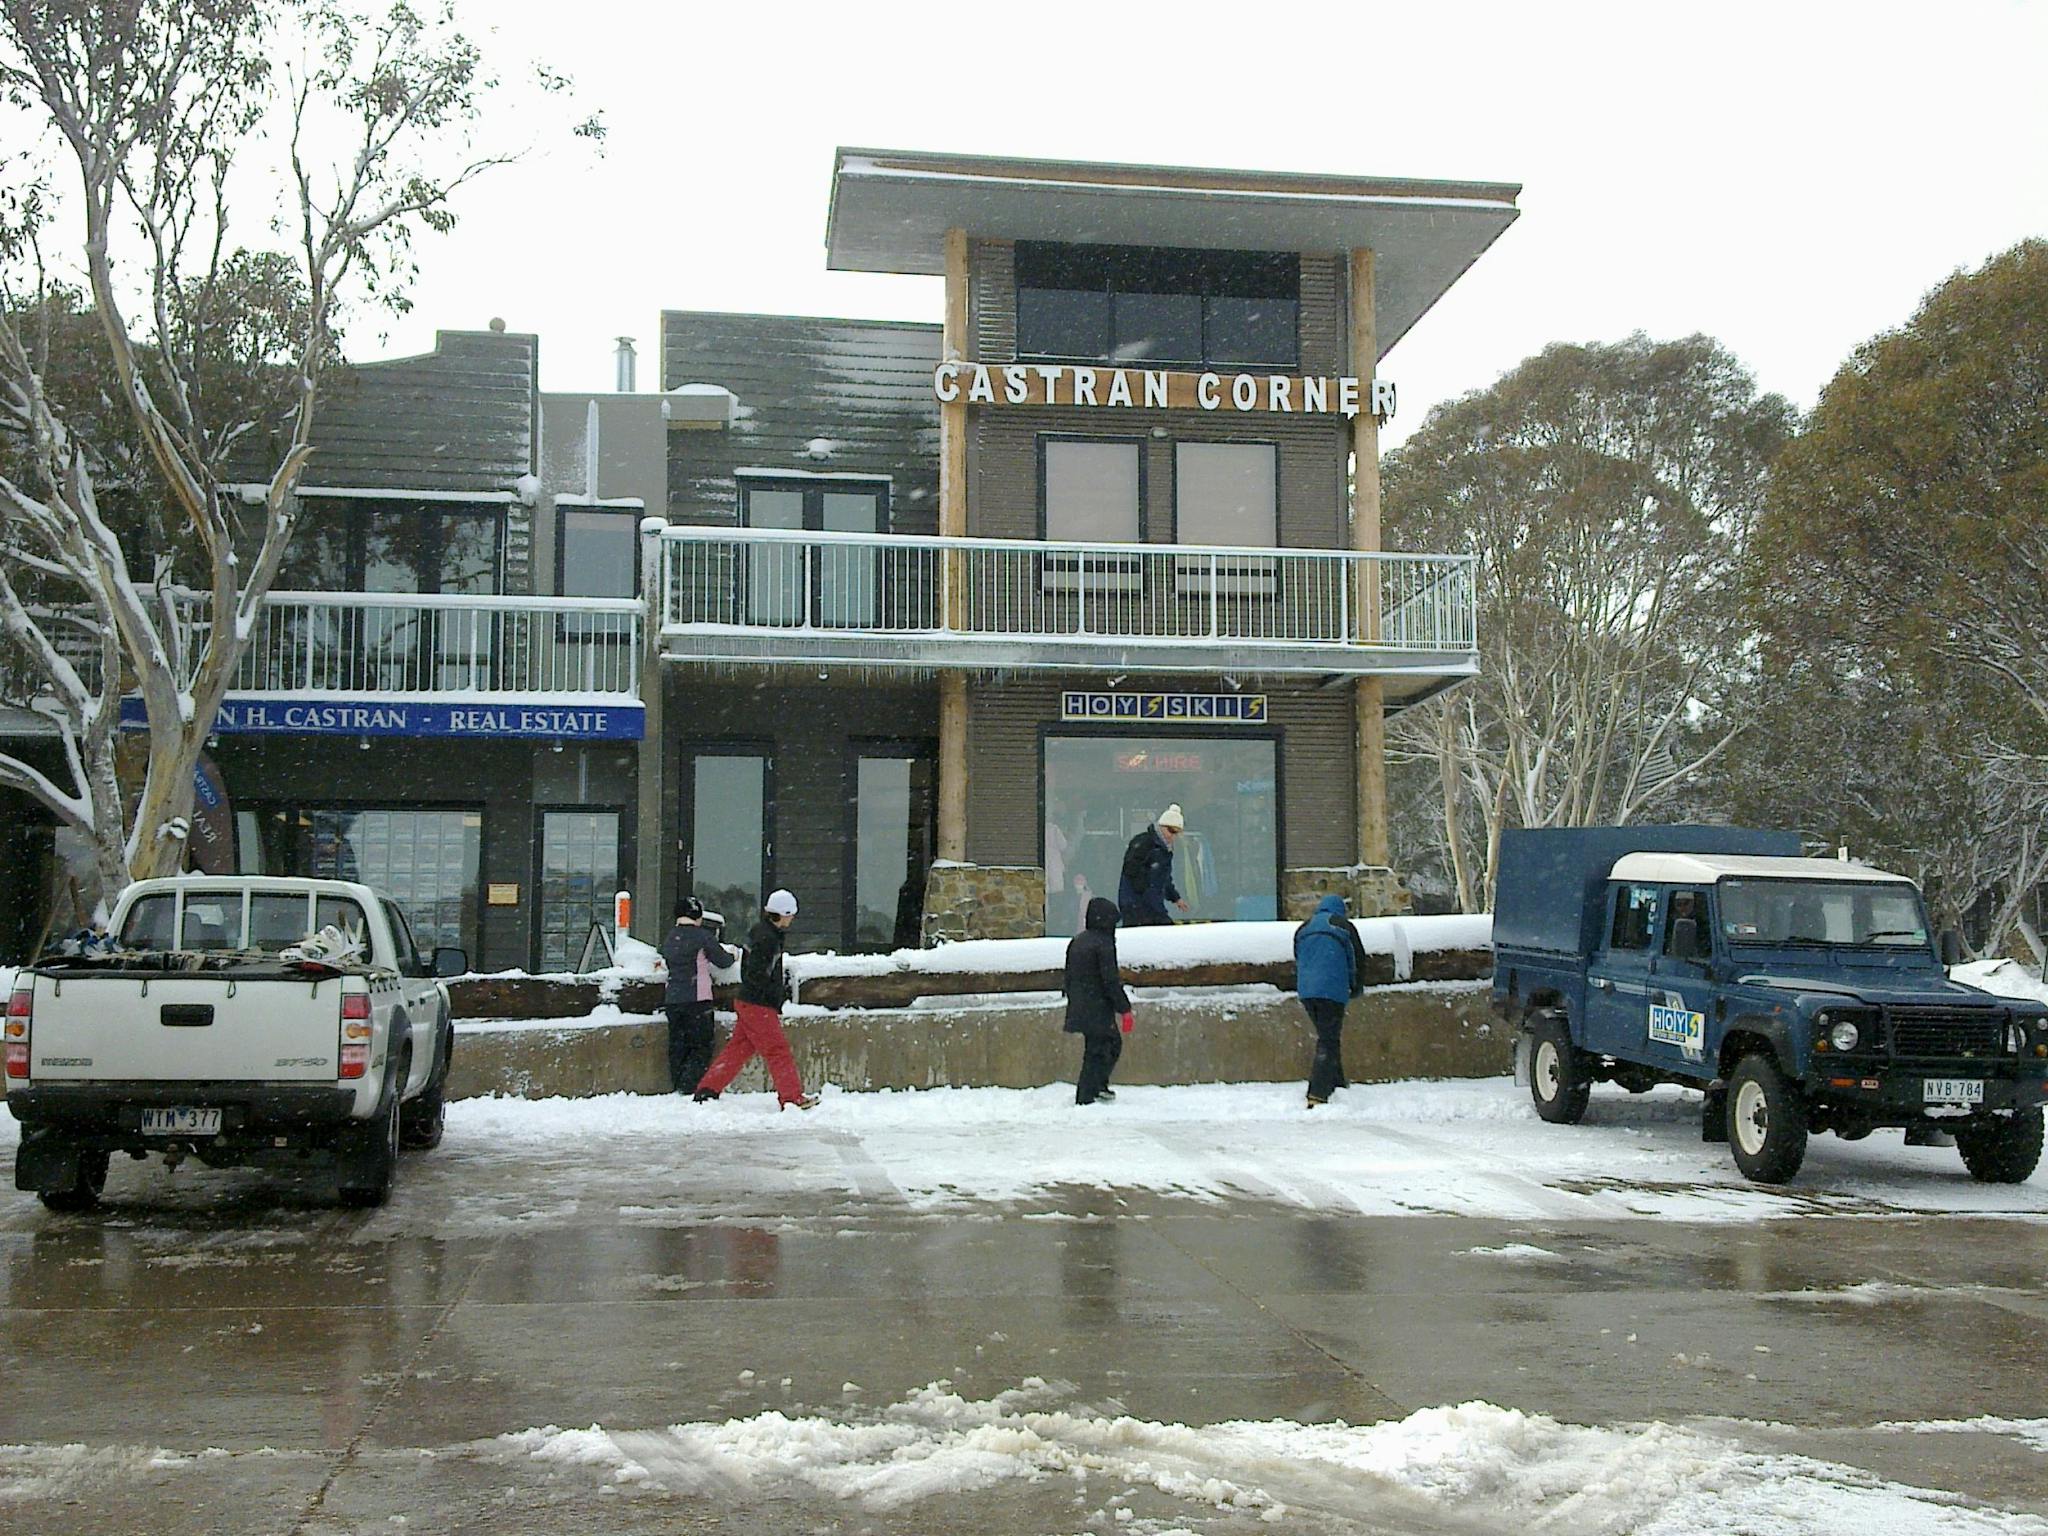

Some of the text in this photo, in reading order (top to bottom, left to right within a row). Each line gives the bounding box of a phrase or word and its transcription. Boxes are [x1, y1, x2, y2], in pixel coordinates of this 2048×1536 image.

[934, 365, 1396, 415] CASTRAN CORNER
[247, 708, 274, 727] H.
[285, 708, 406, 729] CASTRAN
[449, 711, 511, 730] REAL
[520, 712, 607, 732] ESTATE
[1927, 1082, 1981, 1096] NVB 784
[189, 1110, 219, 1128] 377
